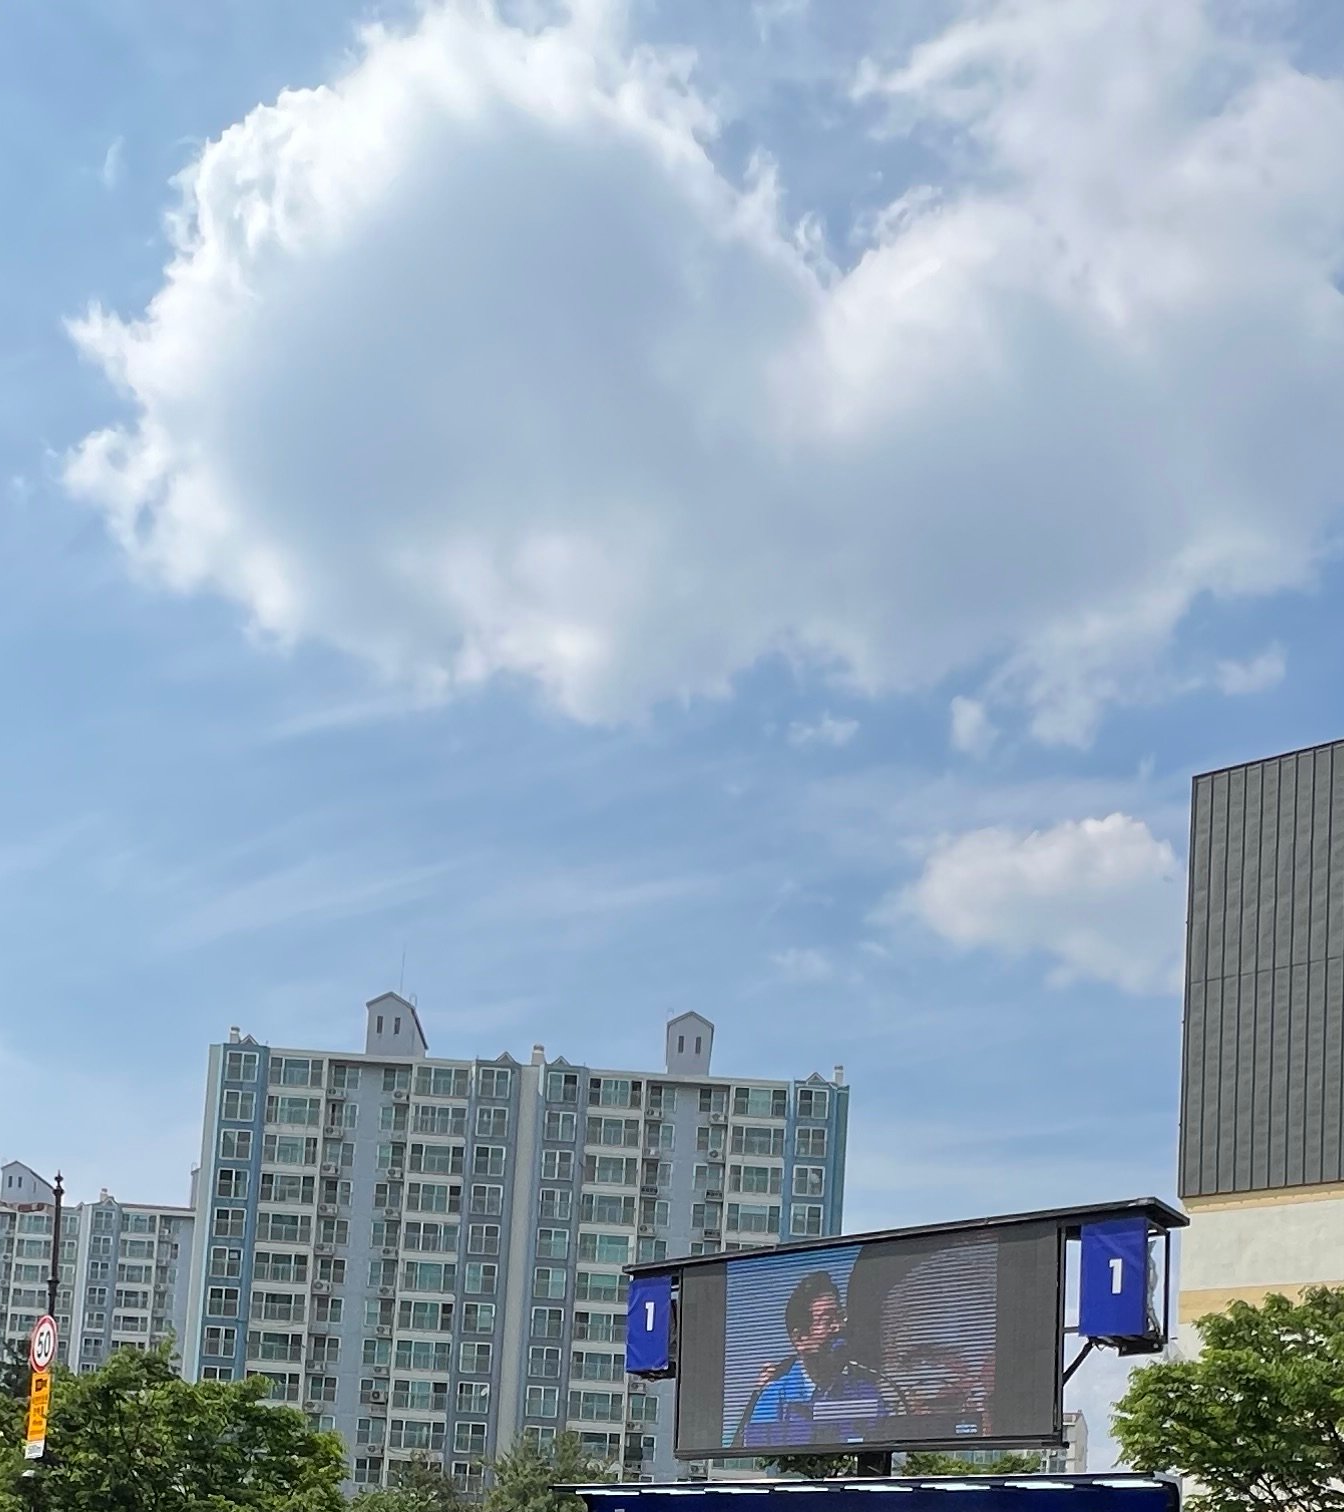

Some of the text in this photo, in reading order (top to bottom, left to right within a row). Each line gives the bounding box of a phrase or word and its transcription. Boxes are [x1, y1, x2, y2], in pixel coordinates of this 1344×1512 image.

[1109, 1259, 1122, 1294] 1
[645, 1302, 654, 1331] 1
[37, 1331, 51, 1359] 50
